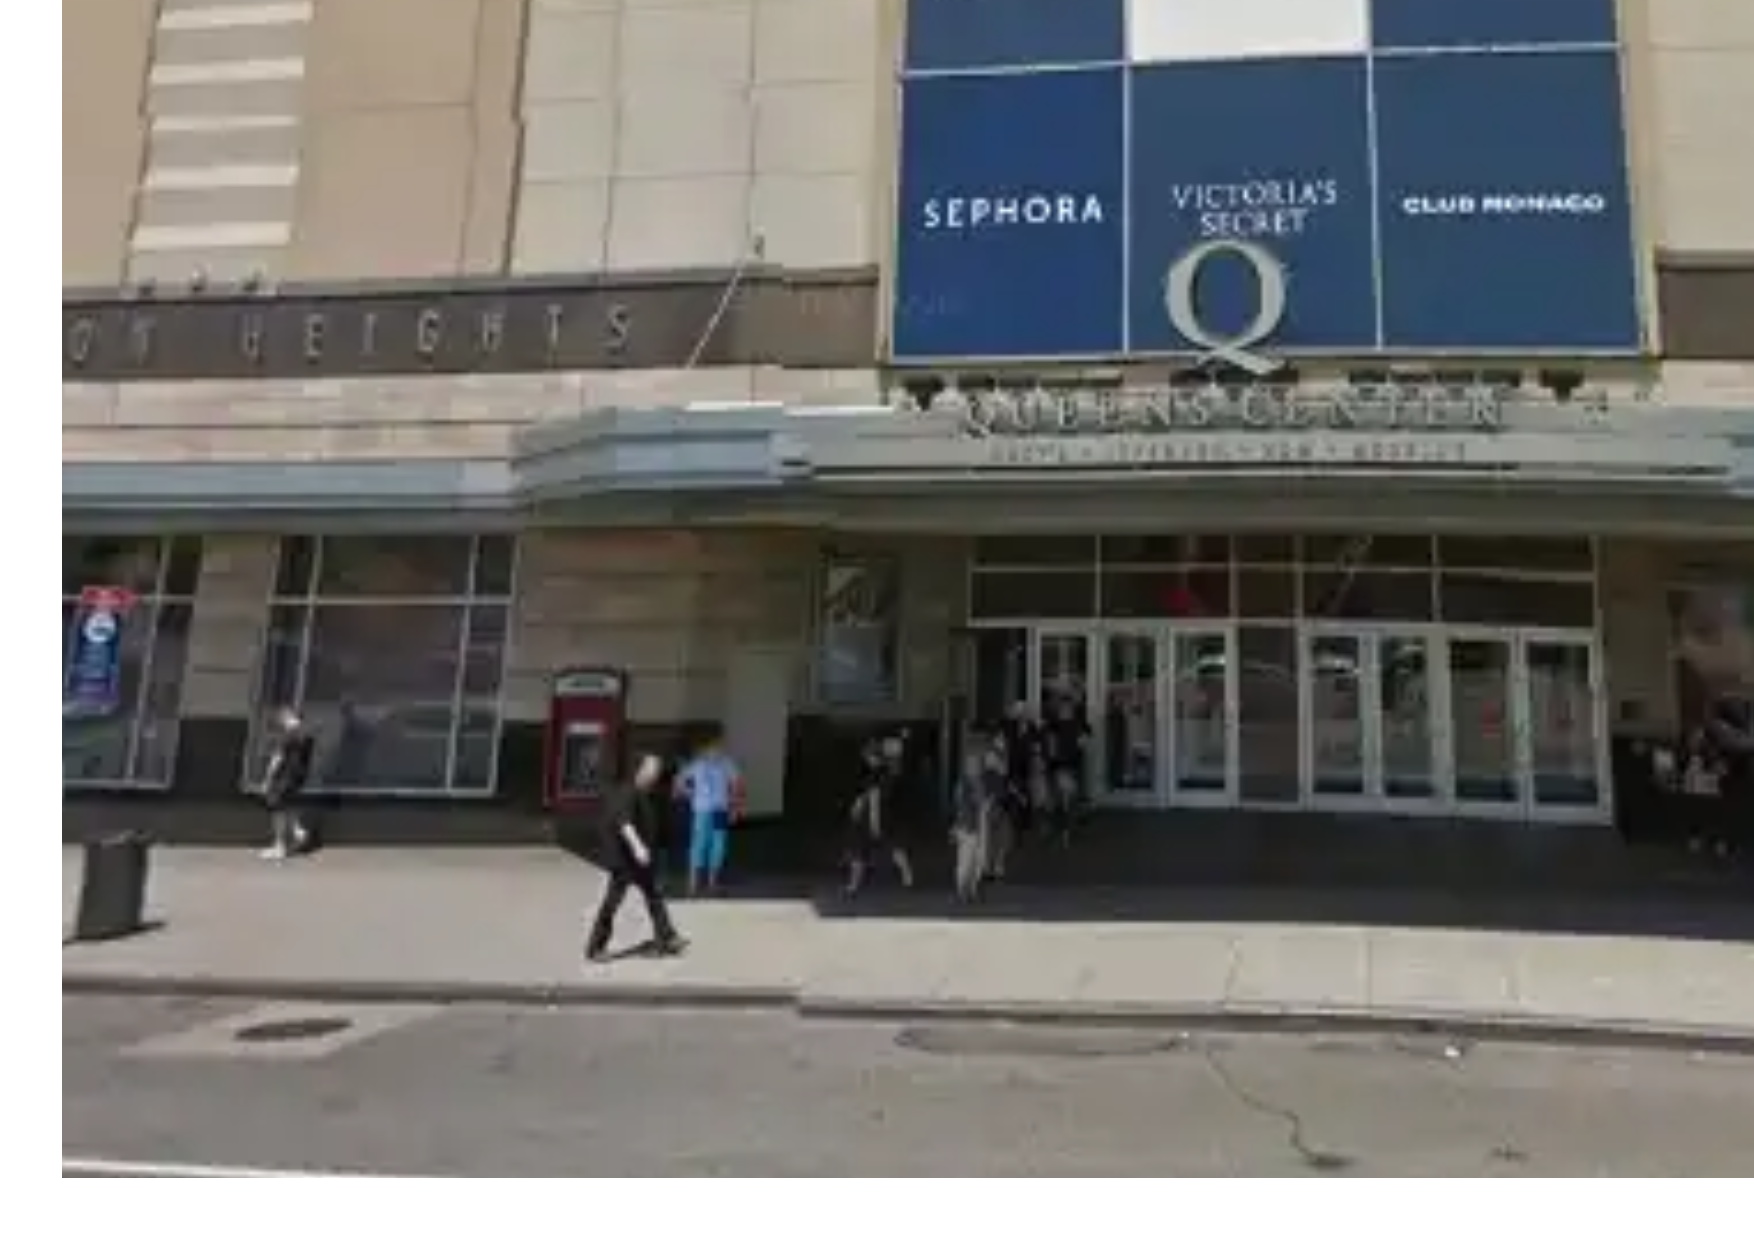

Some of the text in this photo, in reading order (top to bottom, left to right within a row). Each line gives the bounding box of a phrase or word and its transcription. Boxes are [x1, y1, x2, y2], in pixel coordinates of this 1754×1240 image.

[1171, 178, 1337, 210] VICTORIA'S
[1403, 192, 1605, 215] CLUB MONACO
[923, 193, 1103, 229] SEPHORA
[1200, 208, 1309, 237] SECRET
[1164, 240, 1285, 375] Q
